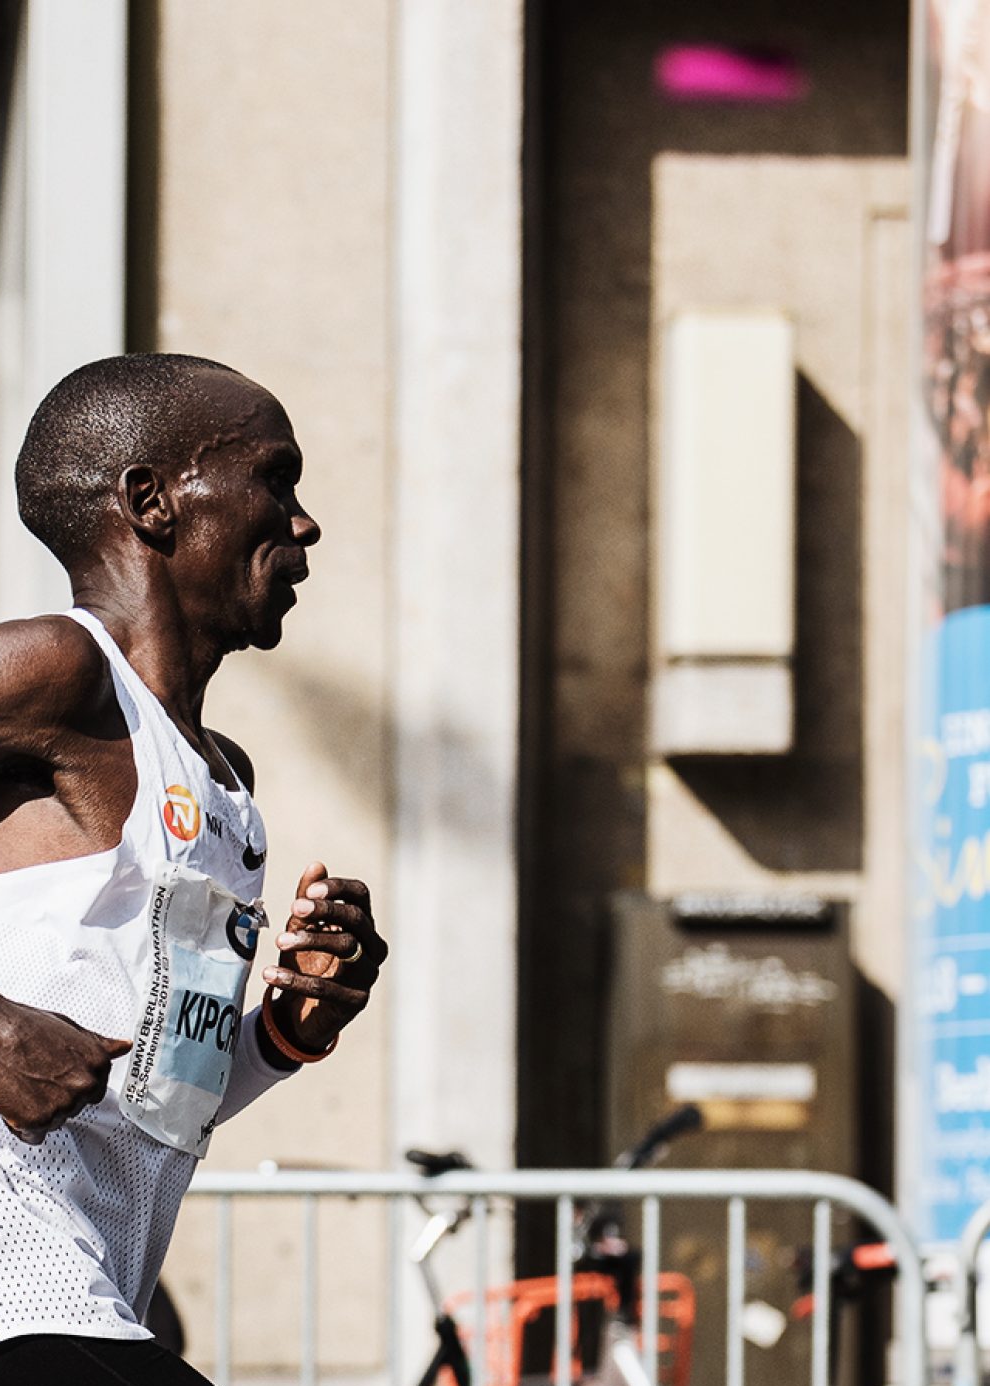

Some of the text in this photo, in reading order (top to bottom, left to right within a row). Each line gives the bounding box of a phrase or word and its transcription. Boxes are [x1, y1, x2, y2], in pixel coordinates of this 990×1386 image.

[126, 886, 166, 1103] 45. BMW BERLIN-MARATHON
[139, 1011, 165, 1082] September
